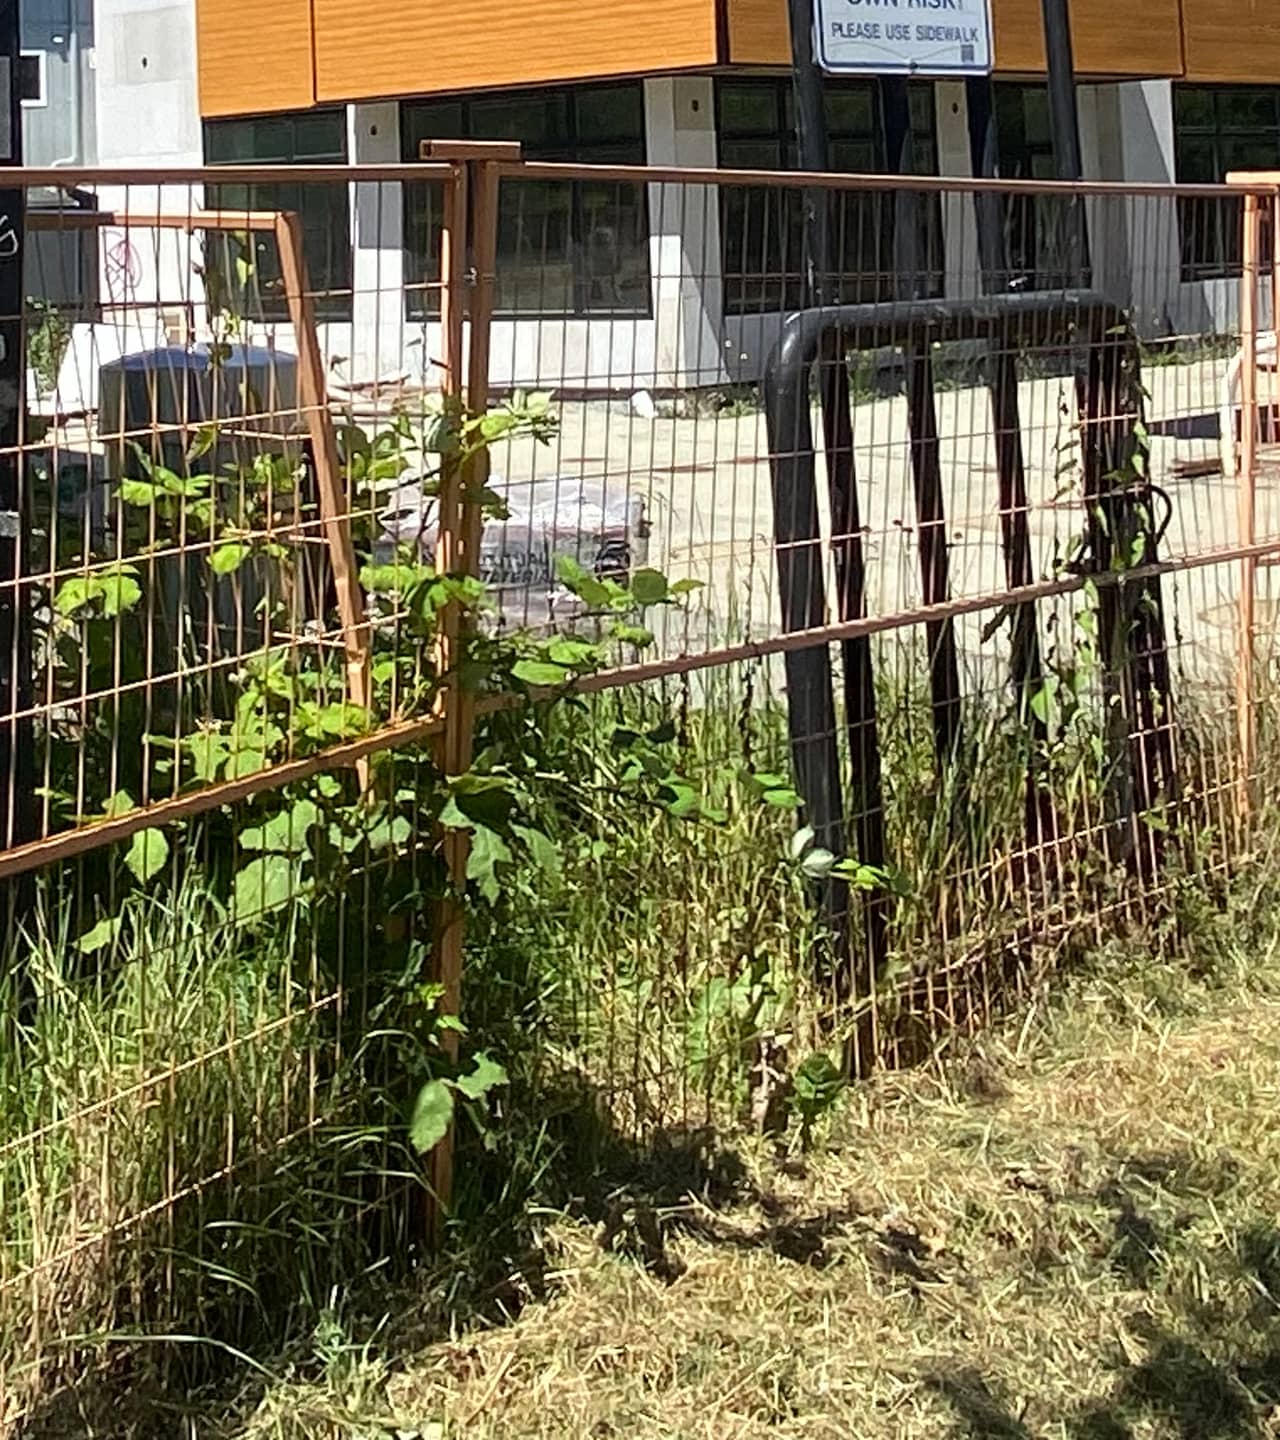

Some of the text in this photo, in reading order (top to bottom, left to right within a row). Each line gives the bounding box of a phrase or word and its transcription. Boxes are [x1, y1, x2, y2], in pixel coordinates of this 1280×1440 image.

[831, 22, 979, 43] PLEASE USE SIDEWALK
